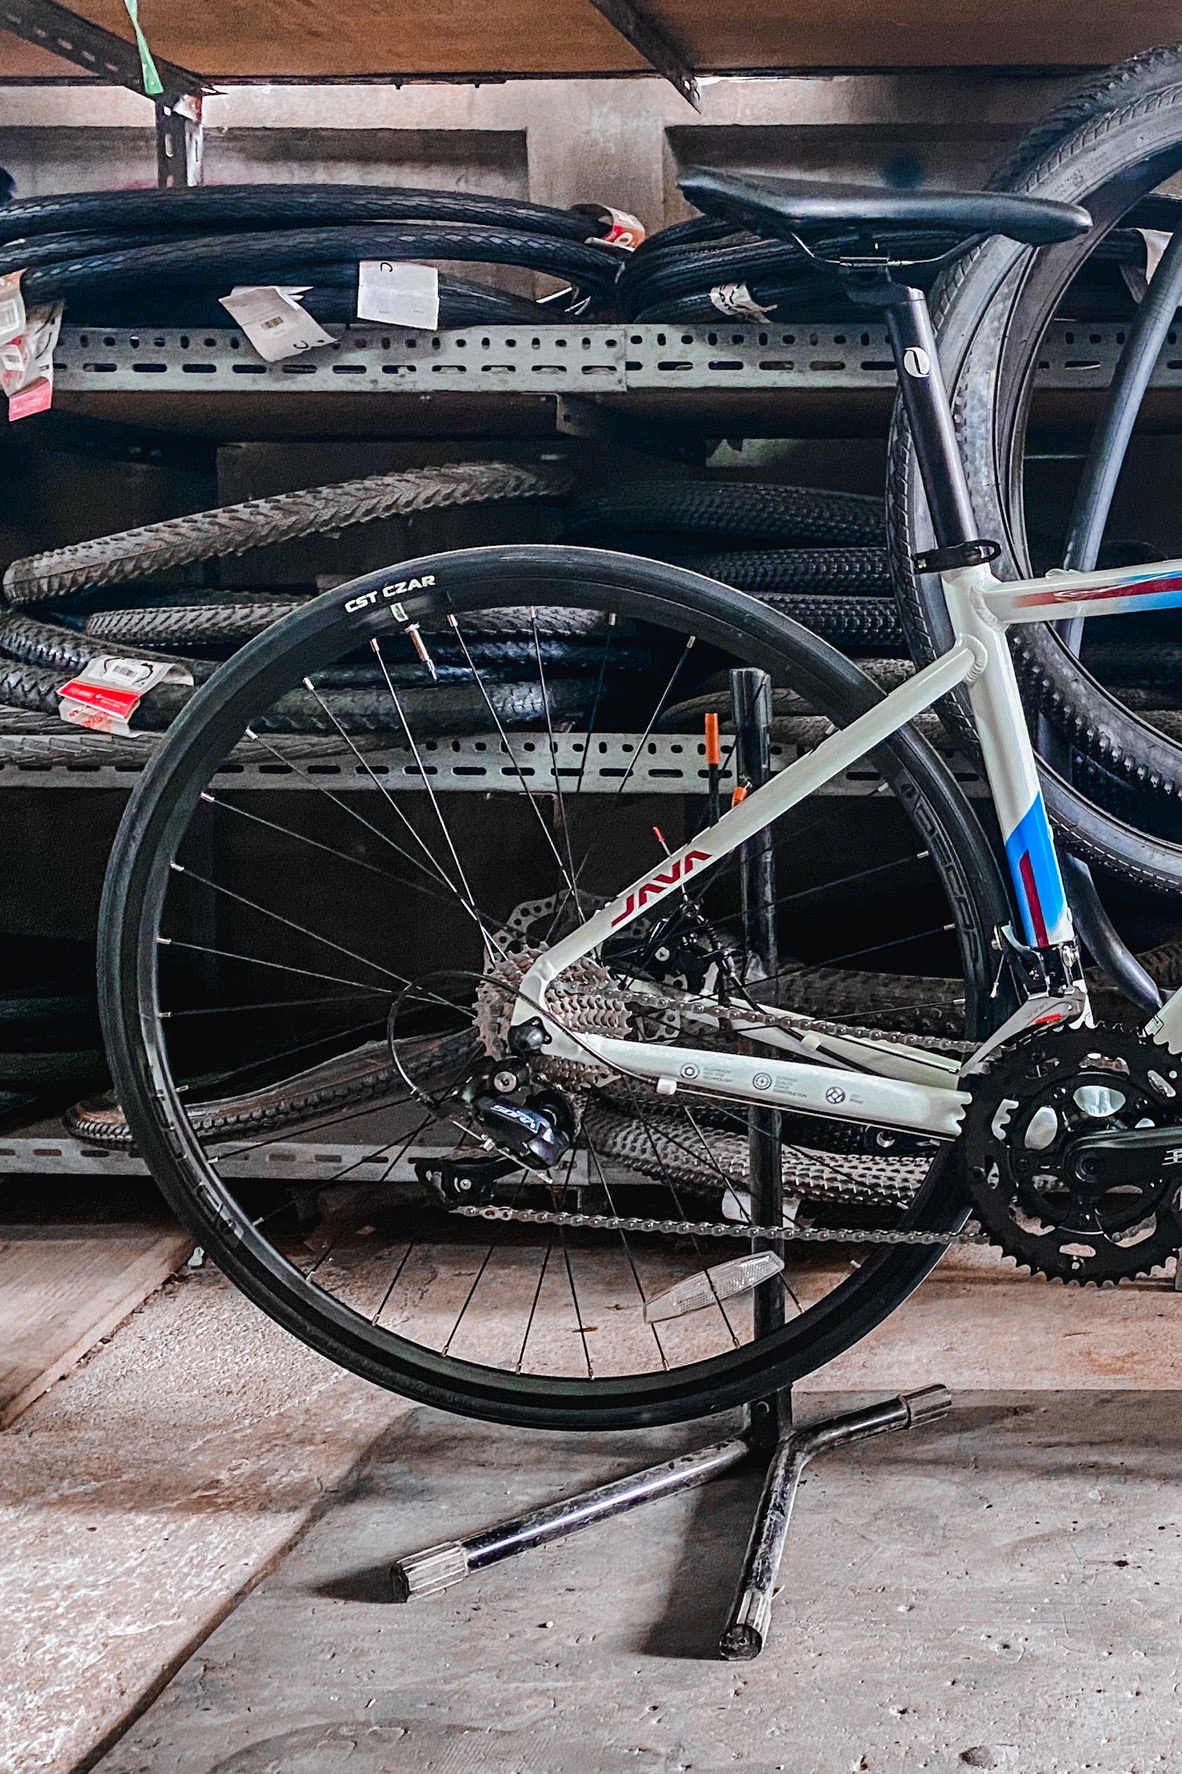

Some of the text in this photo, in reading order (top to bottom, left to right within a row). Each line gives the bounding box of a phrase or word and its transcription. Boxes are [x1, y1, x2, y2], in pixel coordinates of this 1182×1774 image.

[344, 575, 436, 613] CST CZAR
[611, 850, 713, 928] JAVA
